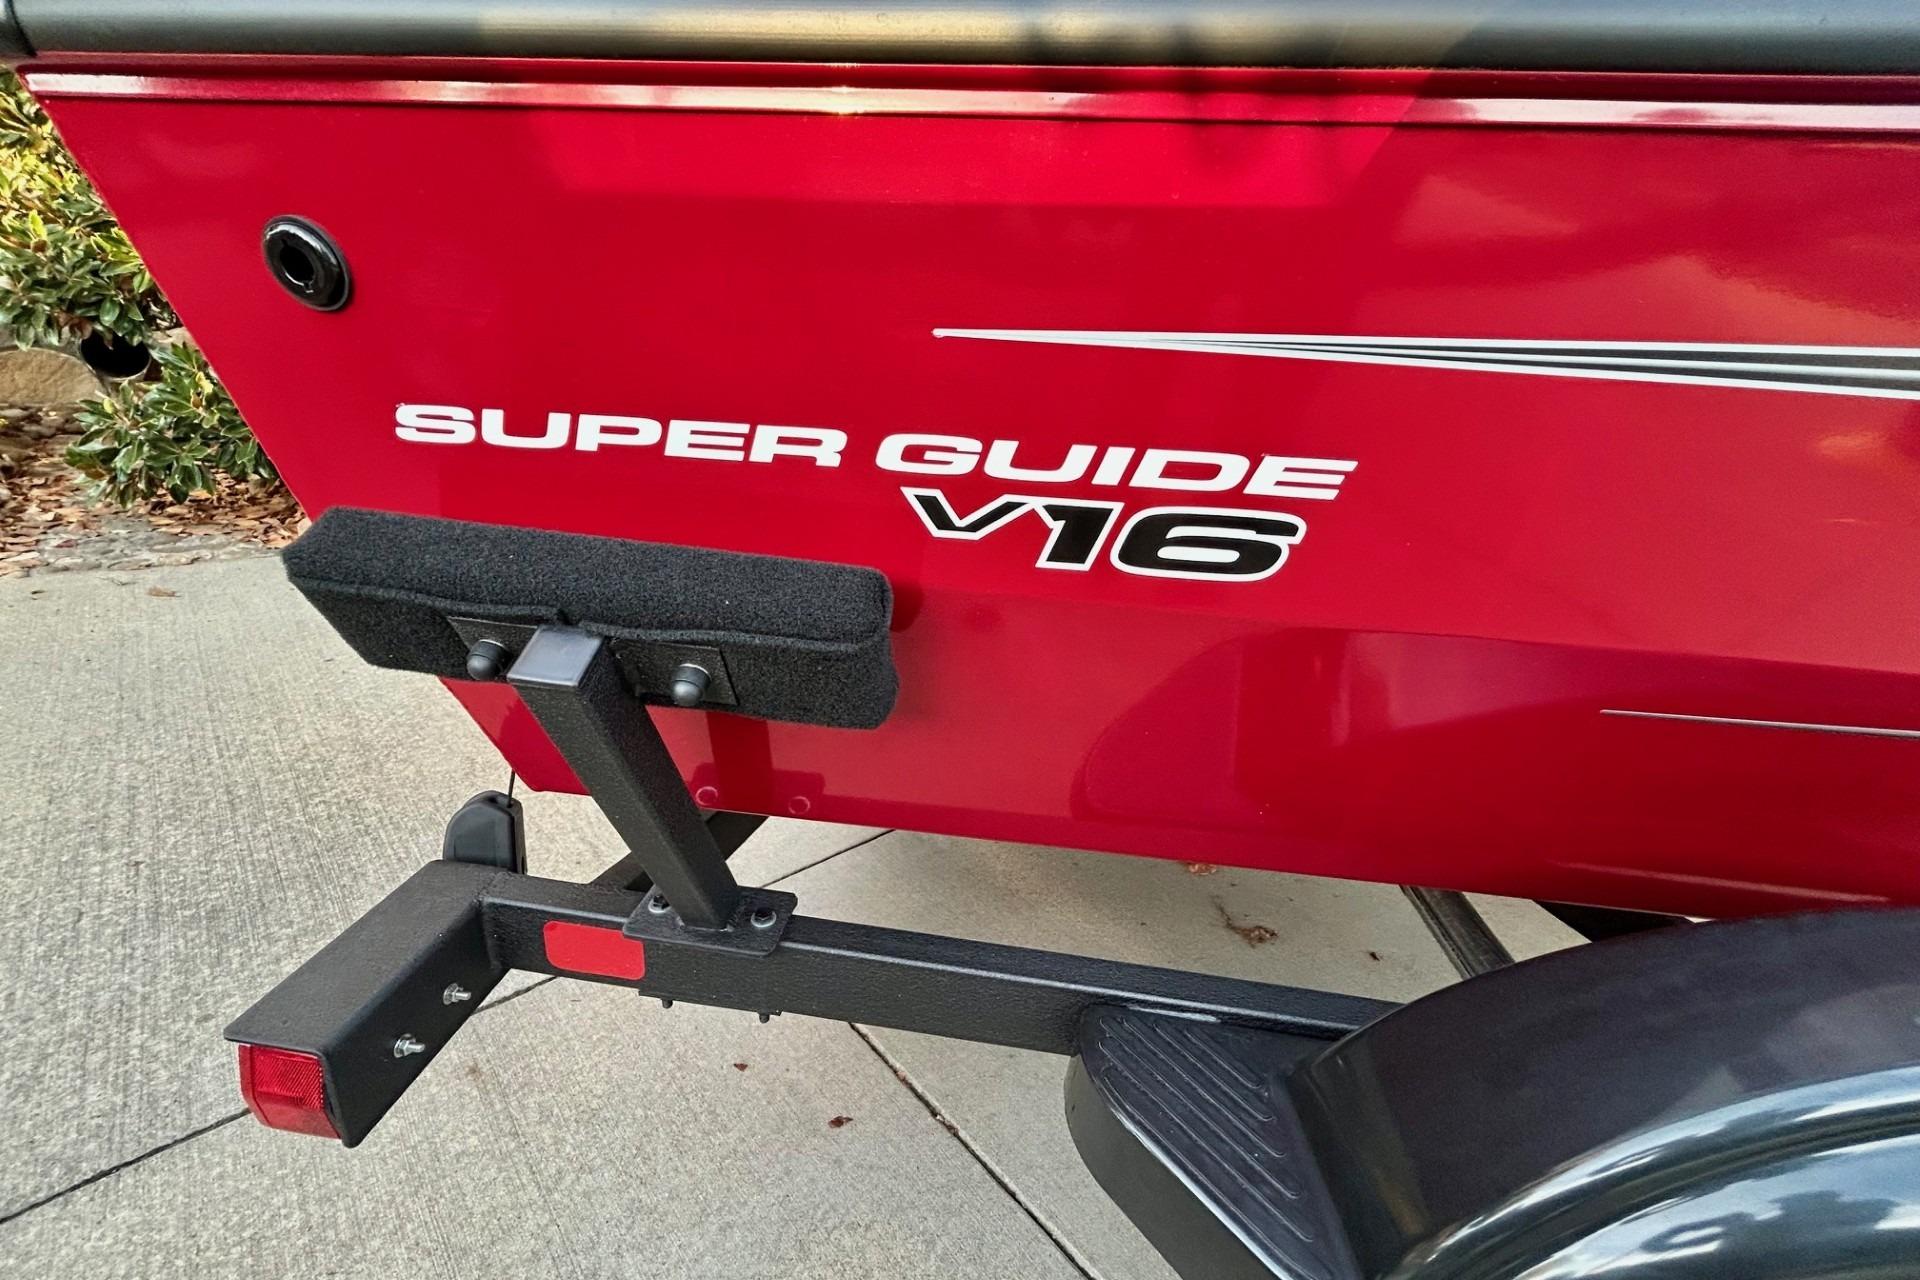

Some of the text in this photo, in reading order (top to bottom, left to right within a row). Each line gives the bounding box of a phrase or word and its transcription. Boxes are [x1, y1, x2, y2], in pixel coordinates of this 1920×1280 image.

[395, 404, 1358, 500] SUPER GUIDE
[900, 486, 1307, 582] V16
